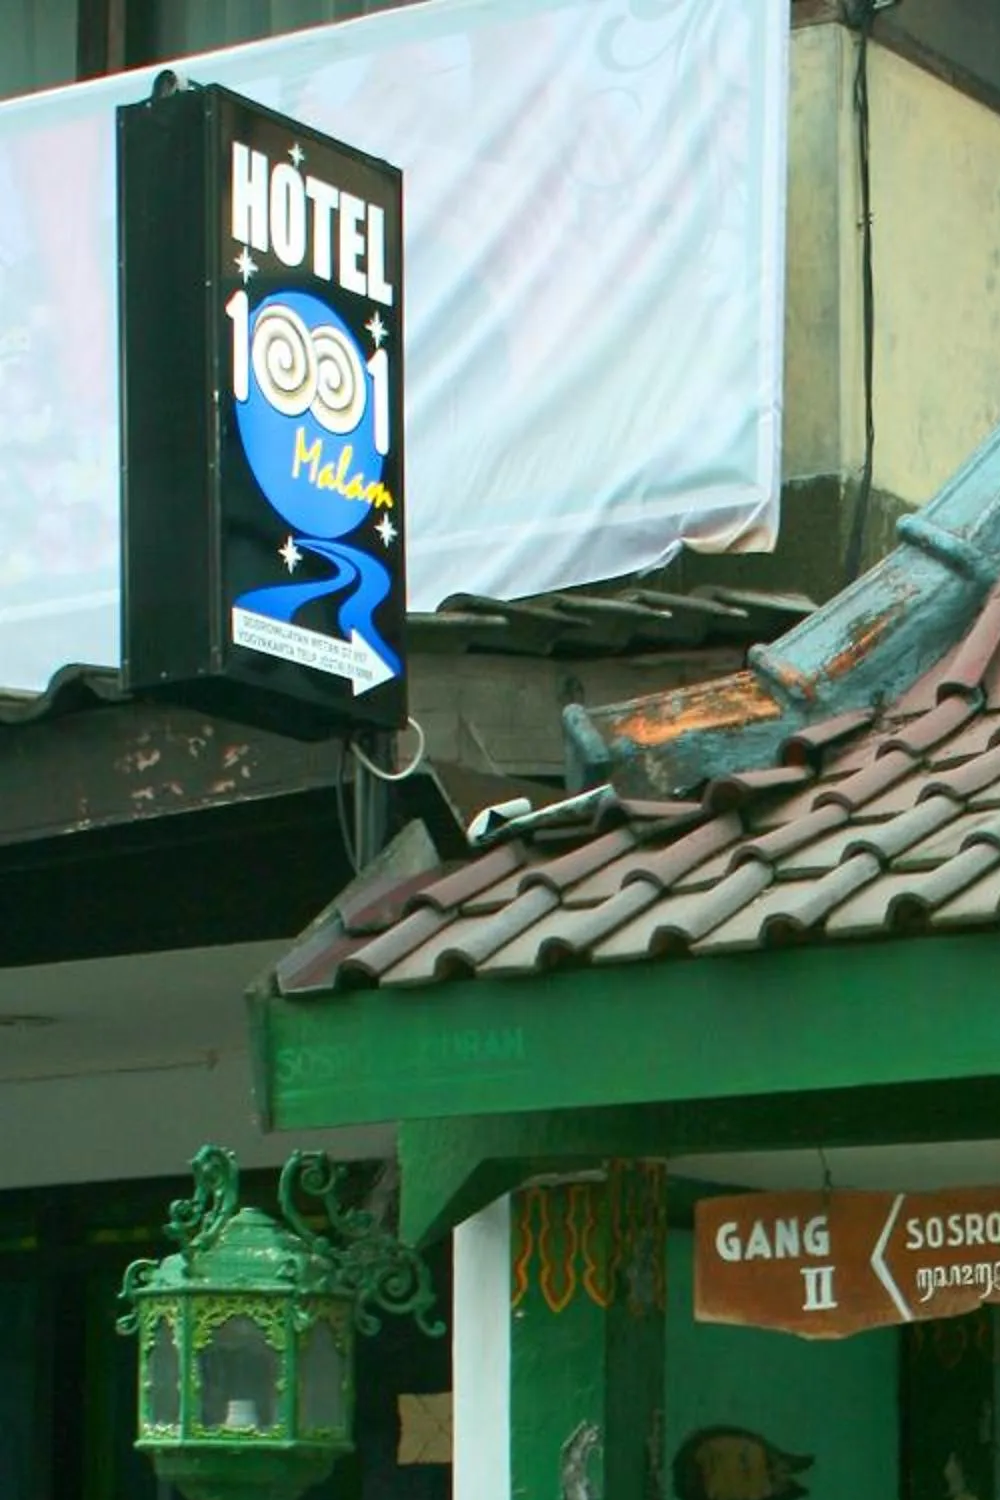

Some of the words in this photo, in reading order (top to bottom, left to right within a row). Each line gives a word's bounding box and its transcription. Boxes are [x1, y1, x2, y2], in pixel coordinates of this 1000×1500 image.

[232, 142, 393, 306] HOTEL
[226, 289, 388, 456] 1001
[292, 427, 393, 508] Malam
[715, 1215, 830, 1261] GANG
[800, 1266, 839, 1312] II
